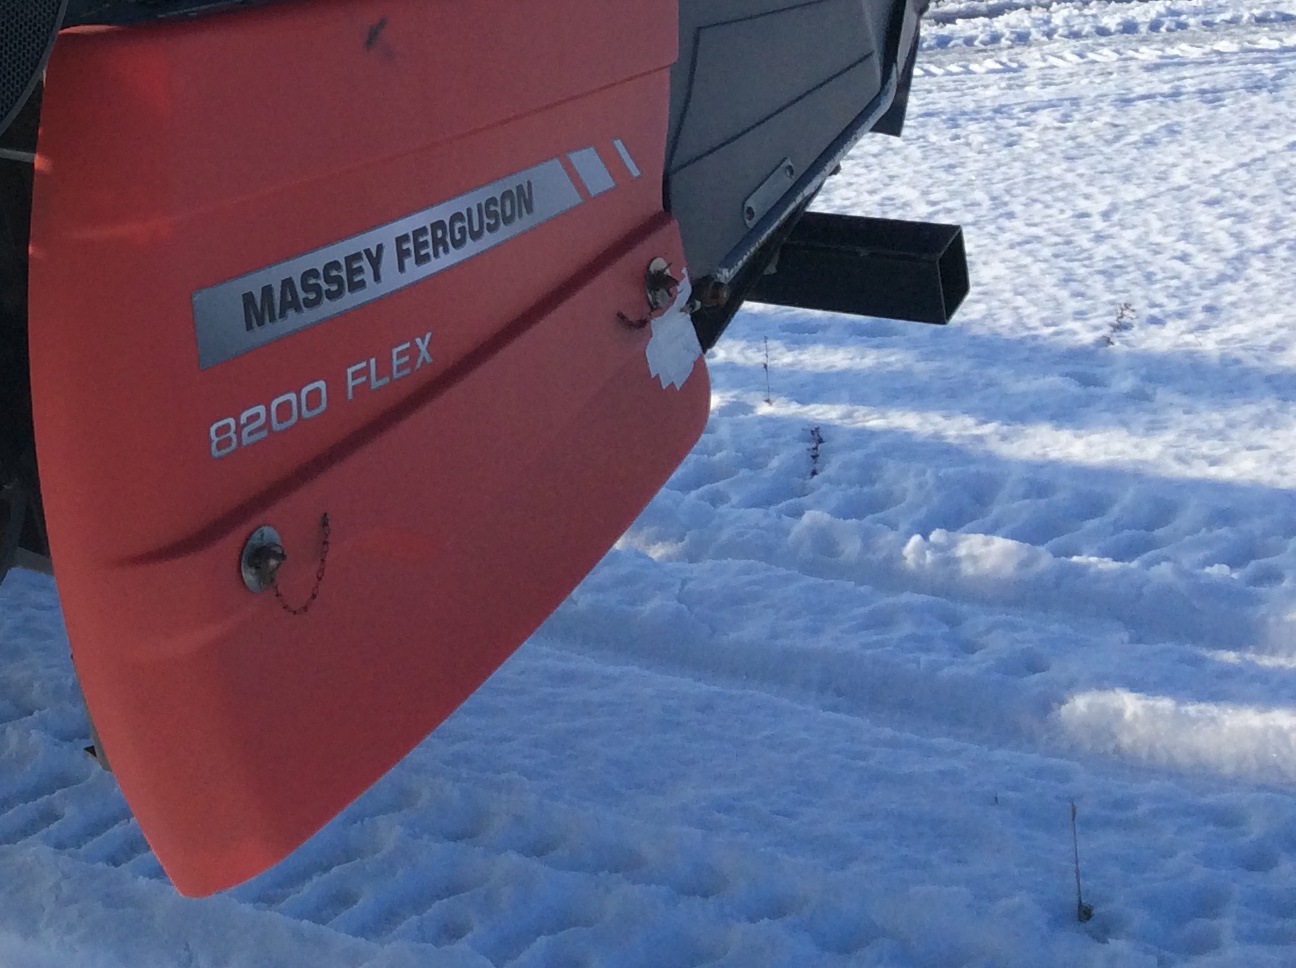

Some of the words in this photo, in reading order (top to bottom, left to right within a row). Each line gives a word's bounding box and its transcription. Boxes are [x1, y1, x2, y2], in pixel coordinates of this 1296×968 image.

[241, 243, 385, 332] MASSEY
[395, 181, 534, 274] FERGUSON
[209, 380, 328, 459] 8200
[347, 332, 434, 401] FLEX
